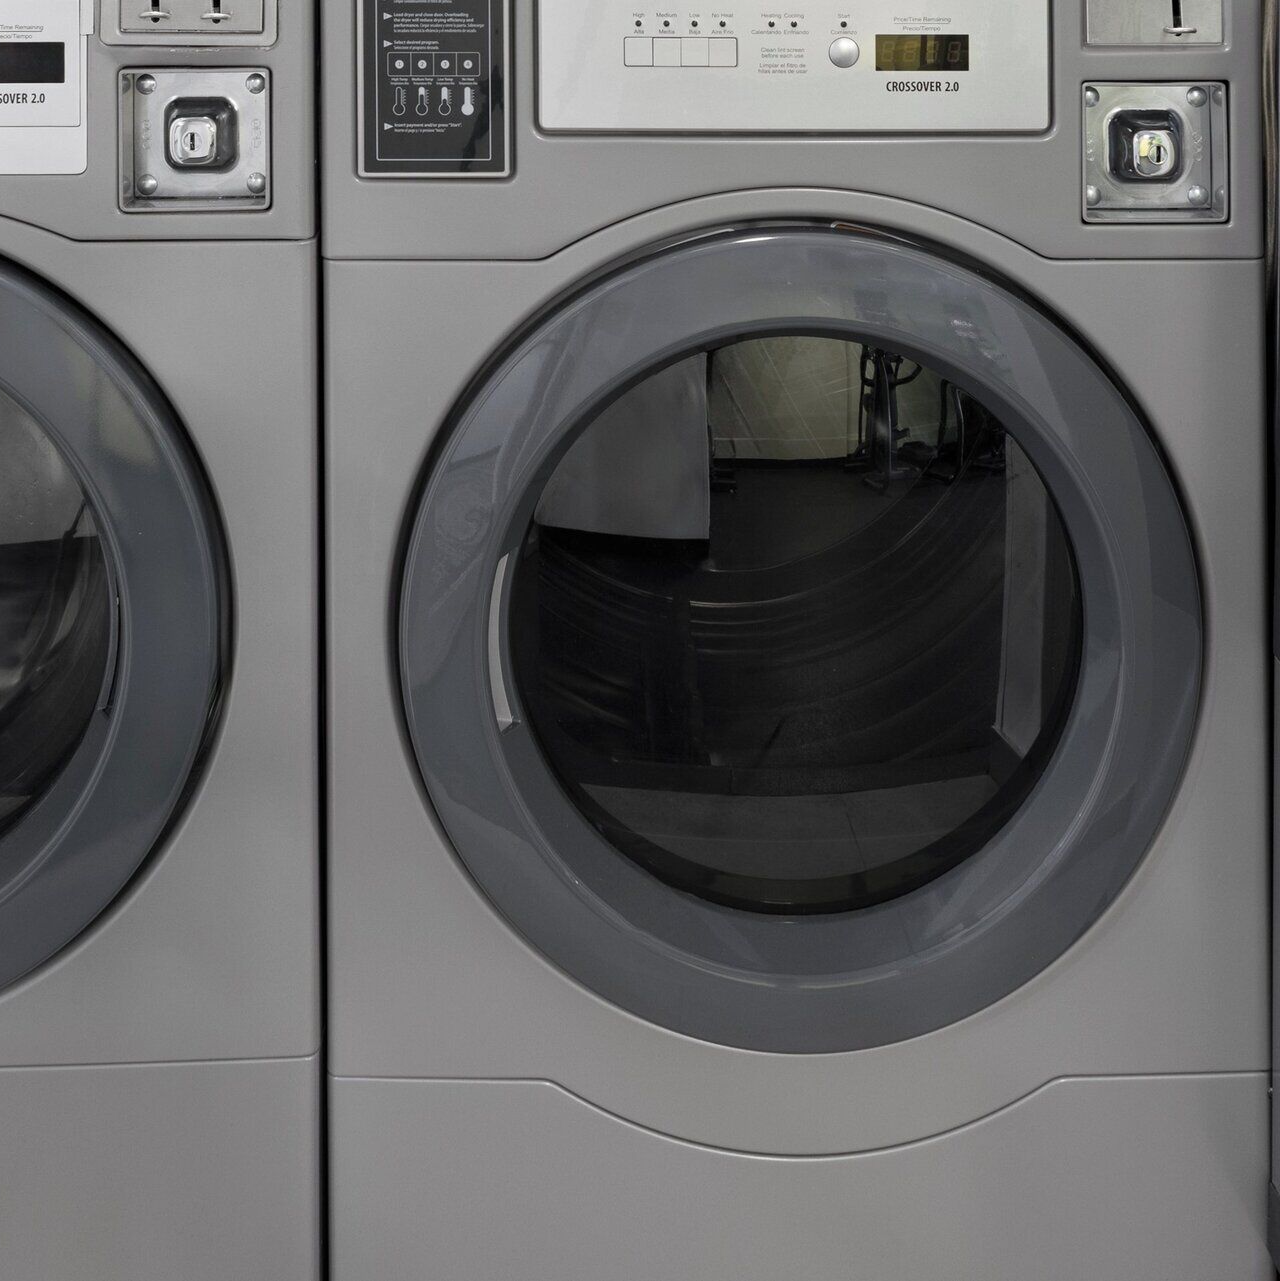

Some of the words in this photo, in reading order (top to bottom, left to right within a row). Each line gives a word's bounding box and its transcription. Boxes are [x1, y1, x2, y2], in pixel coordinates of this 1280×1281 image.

[886, 82, 941, 91] CROSSOVER
[945, 82, 959, 91] 2.0
[31, 93, 46, 104] 2.0
